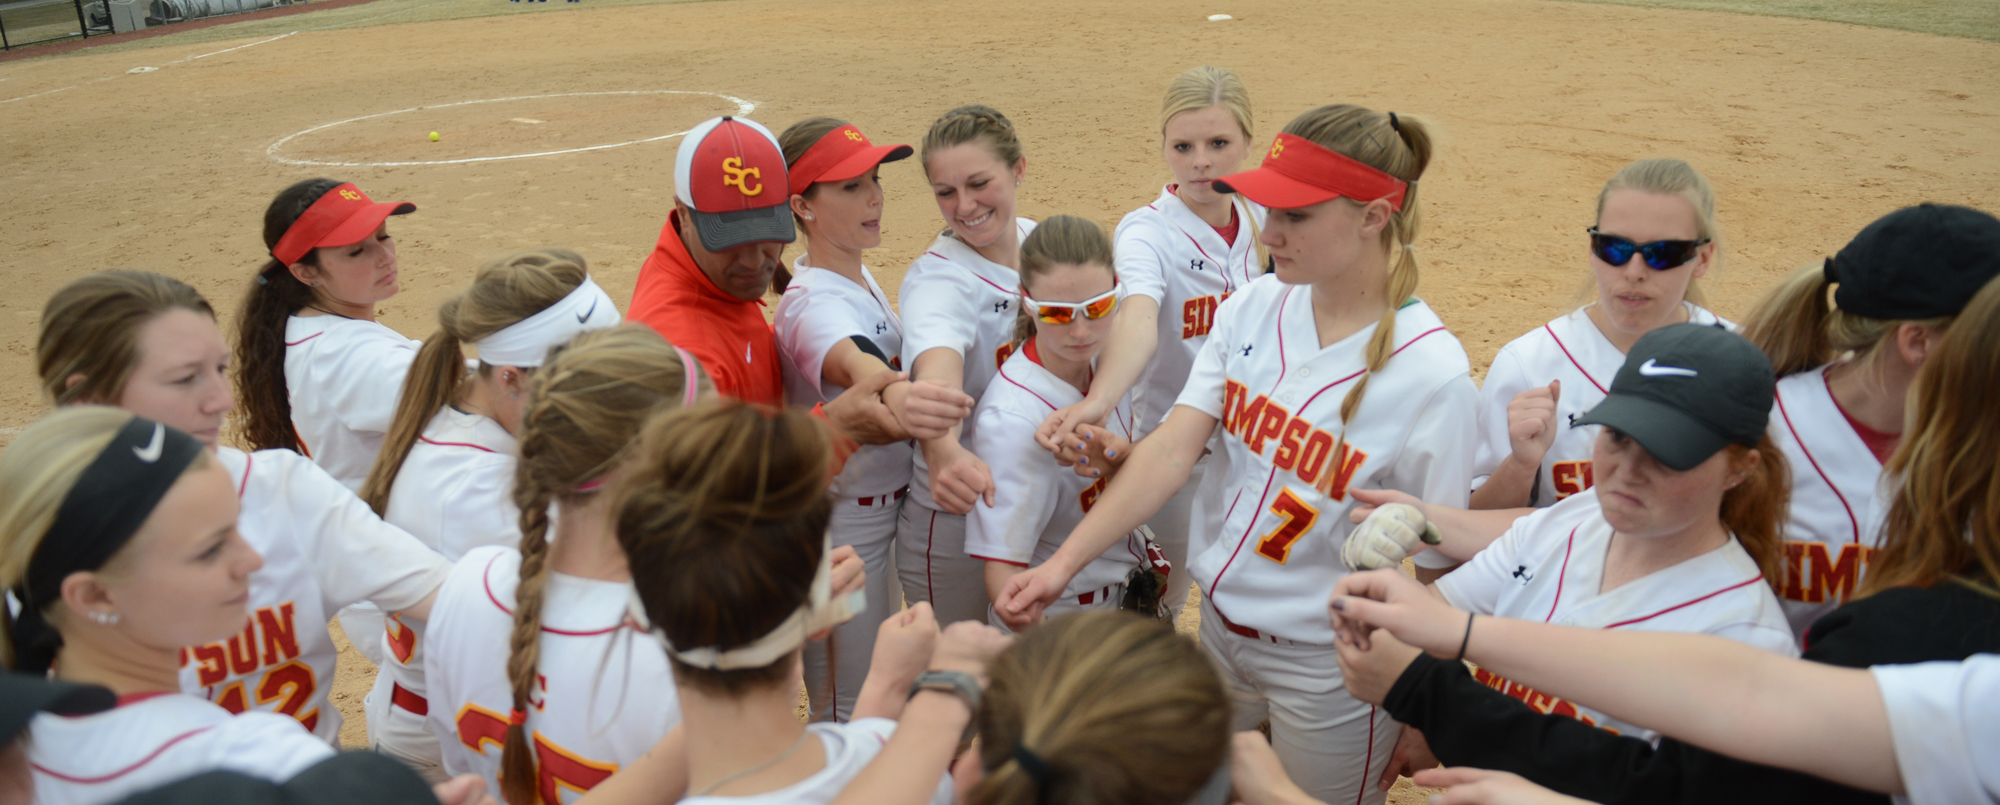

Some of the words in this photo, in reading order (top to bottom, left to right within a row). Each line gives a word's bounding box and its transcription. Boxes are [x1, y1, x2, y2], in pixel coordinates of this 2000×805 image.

[722, 156, 763, 196] SC
[1254, 485, 1320, 566] 7
[179, 600, 302, 688] SON
